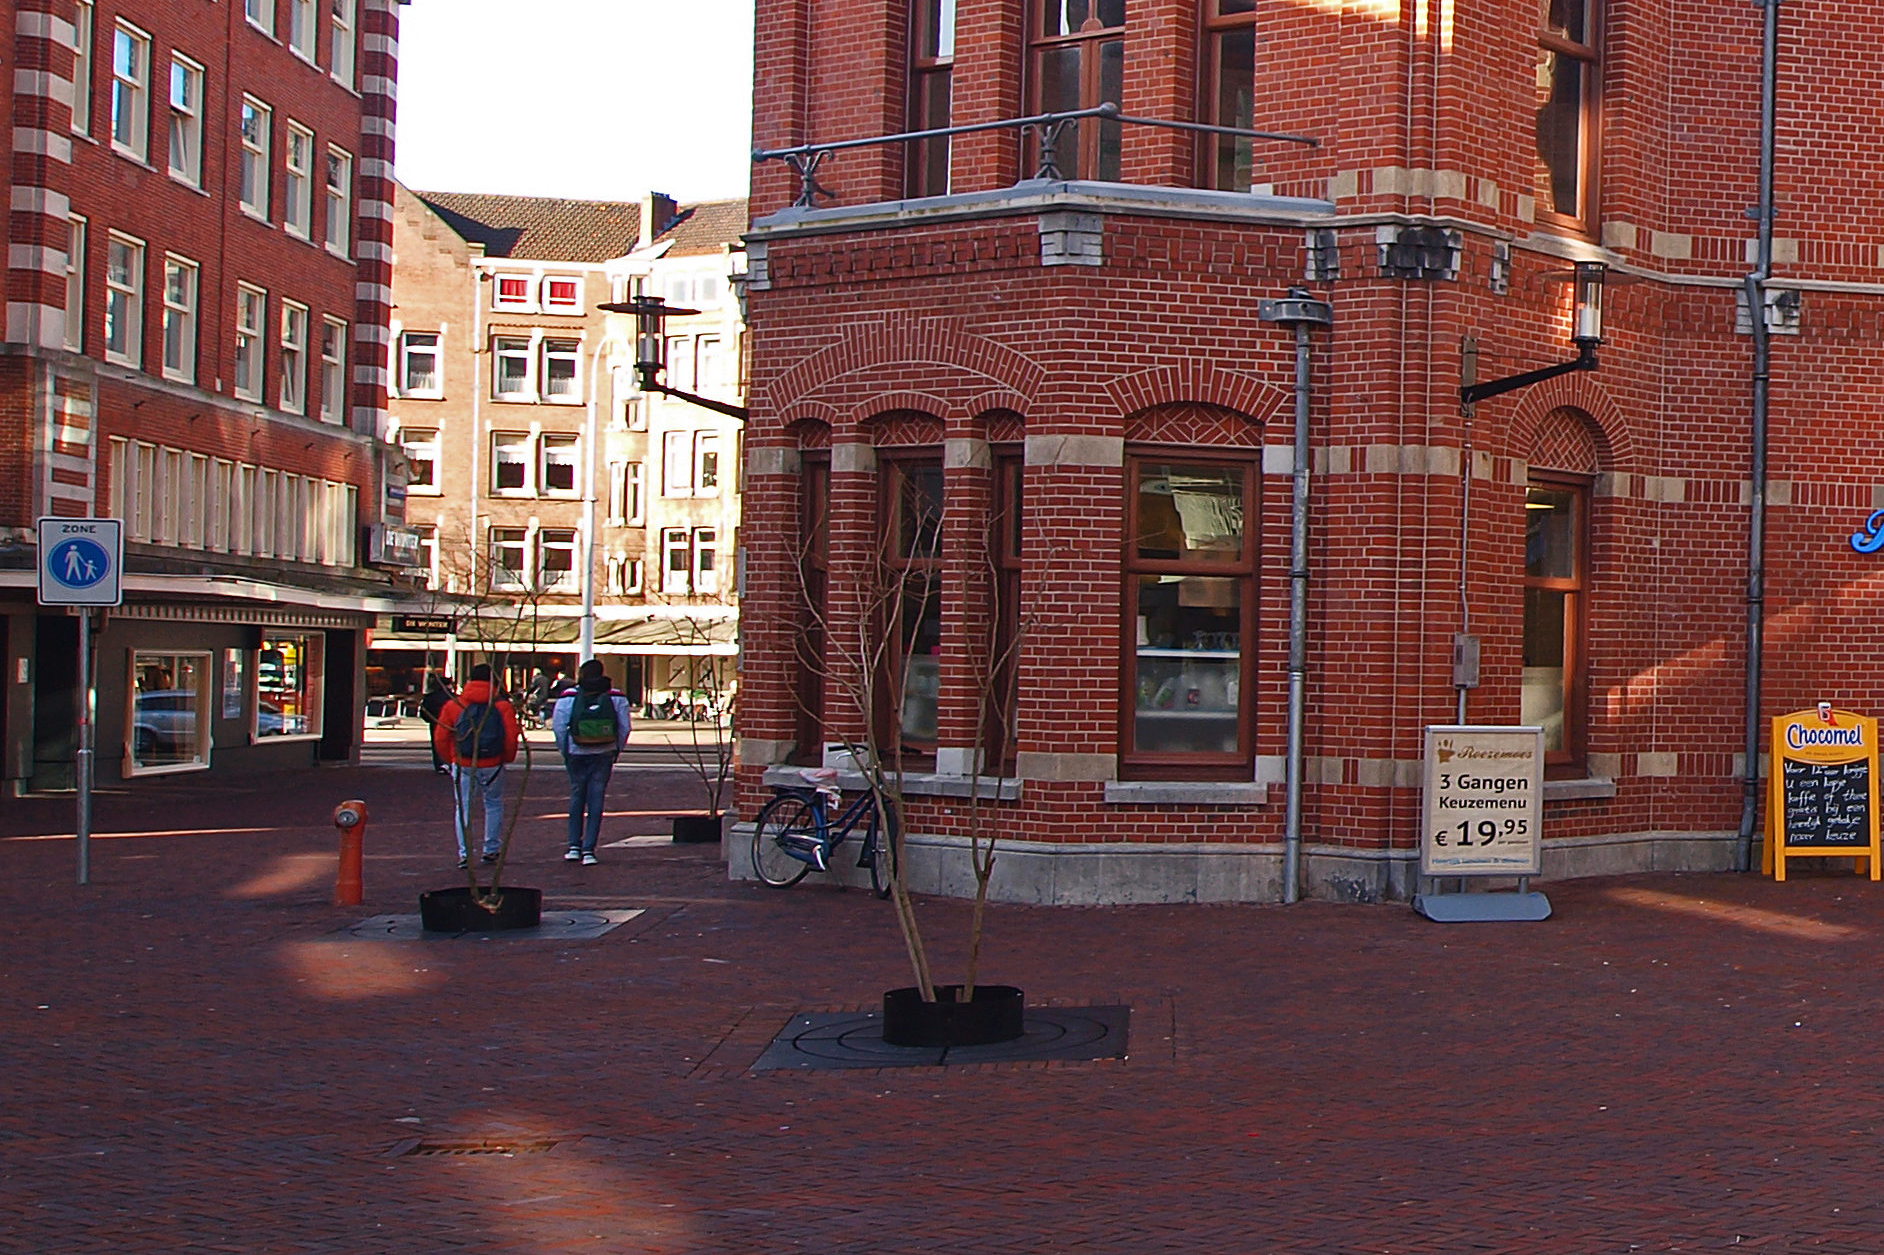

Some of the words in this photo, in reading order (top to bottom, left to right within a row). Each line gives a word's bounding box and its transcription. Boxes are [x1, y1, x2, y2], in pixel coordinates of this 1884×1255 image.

[62, 524, 96, 533] ZONE
[1786, 723, 1863, 749] Chocomel
[1440, 774, 1451, 790] 3
[1457, 774, 1528, 794] Gangen
[1440, 796, 1527, 809] Keuzemenu
[1435, 831, 1448, 847] €
[1456, 819, 1528, 847] 19,95
